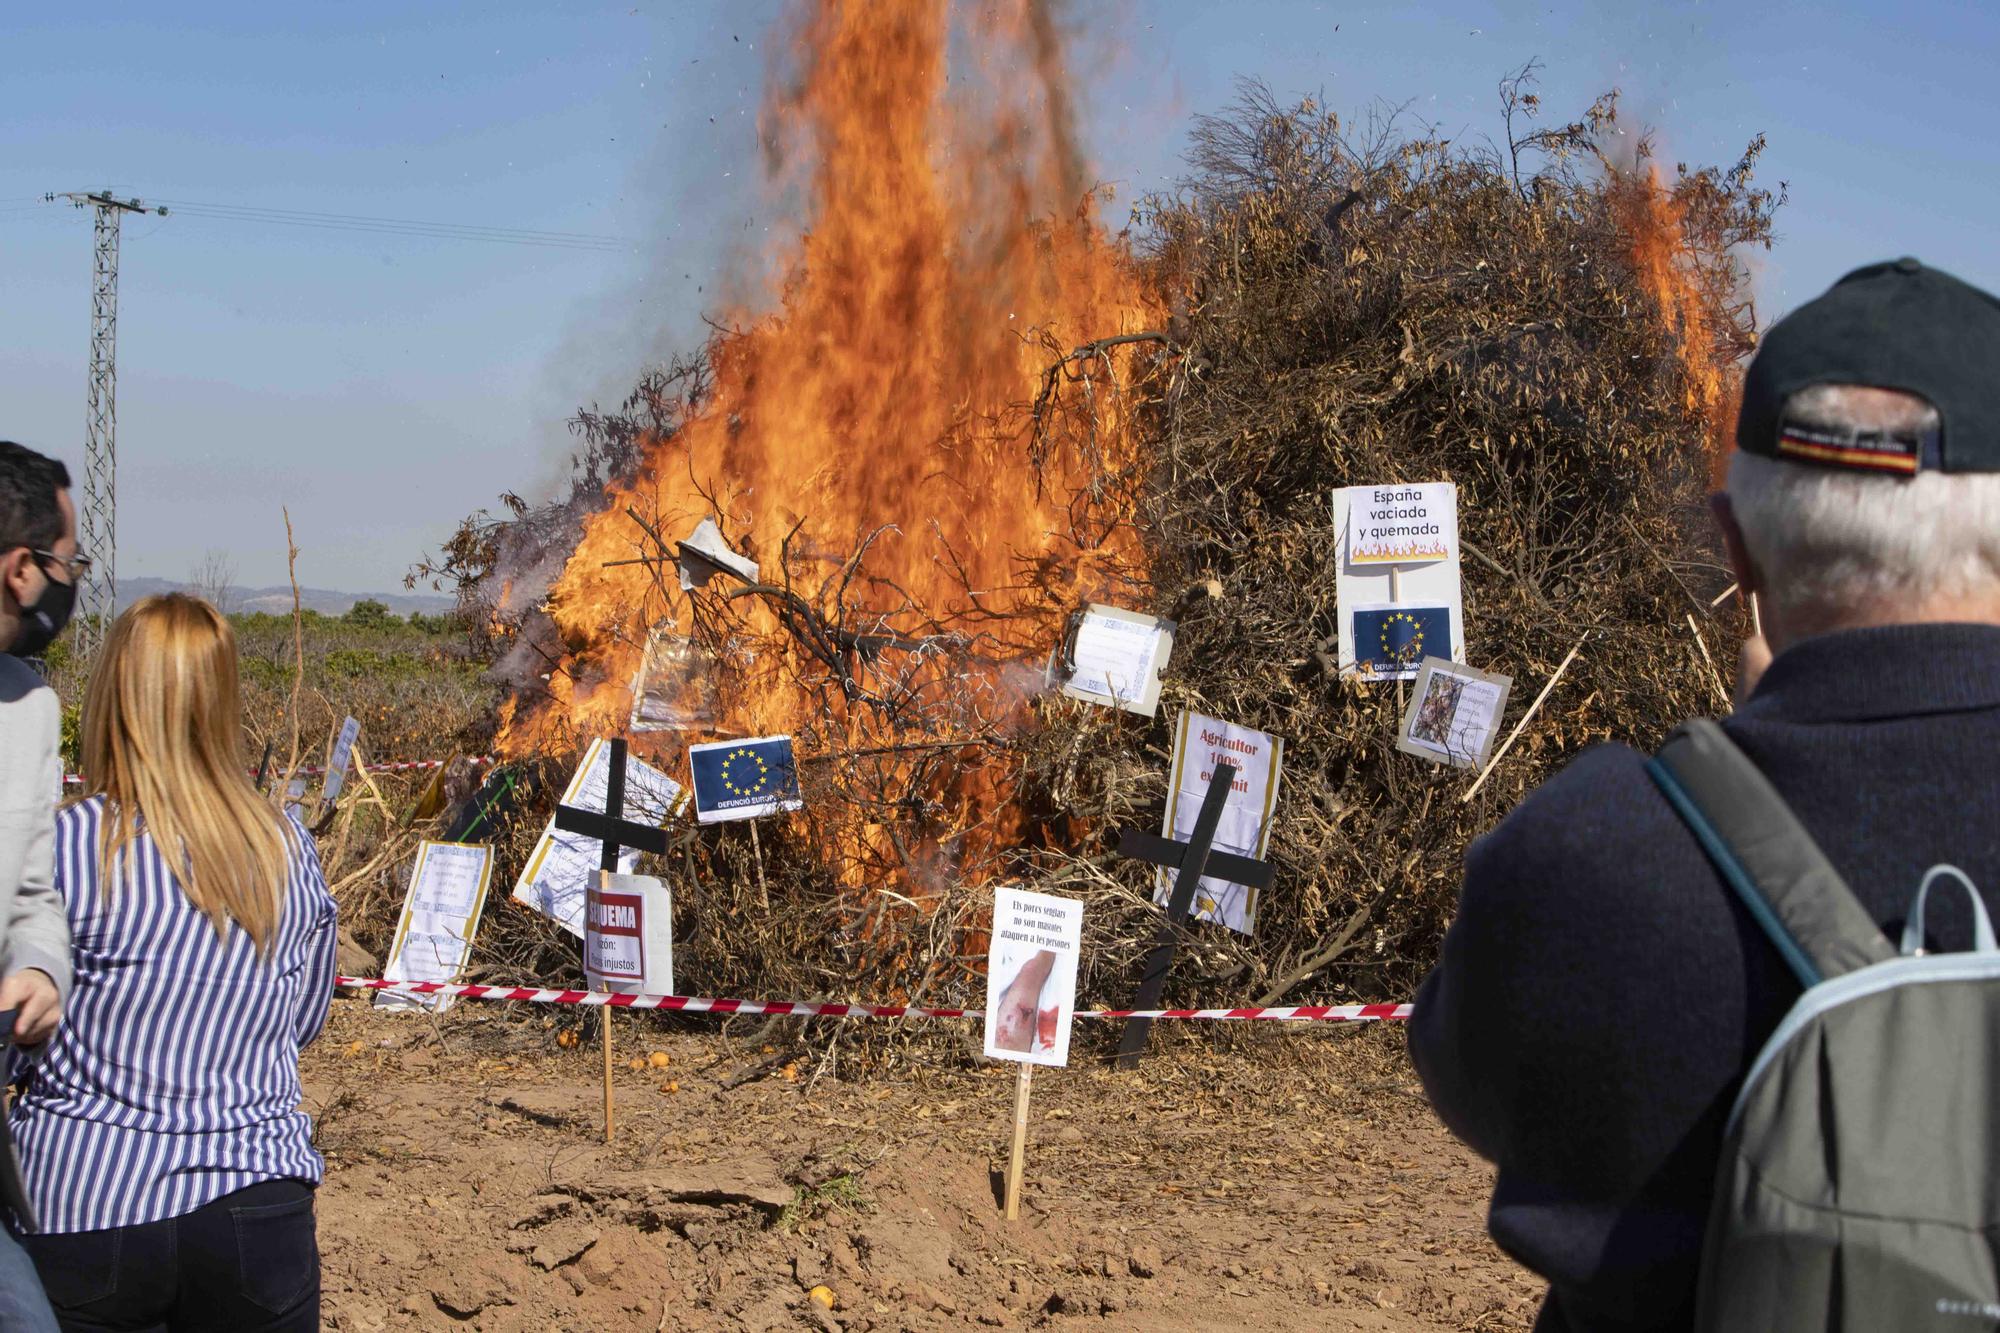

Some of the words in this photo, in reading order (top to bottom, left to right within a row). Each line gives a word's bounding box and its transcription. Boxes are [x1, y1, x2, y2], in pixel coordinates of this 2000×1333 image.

[1374, 489, 1422, 504] España
[1370, 506, 1427, 520] vaciada
[1360, 528, 1367, 541] y
[1371, 523, 1439, 540] quemada
[1200, 729, 1258, 756] Agricultor
[1211, 751, 1243, 772] 100%
[751, 795, 776, 804] EUROP
[1013, 900, 1022, 910] Els
[1023, 903, 1042, 913] porcs
[1013, 917, 1022, 925] no
[1023, 919, 1036, 928] son
[1000, 930, 1029, 941] ataquen
[1030, 935, 1035, 943] a
[1036, 934, 1045, 944] les
[1046, 938, 1070, 949] persones
[604, 957, 635, 971] injustos
